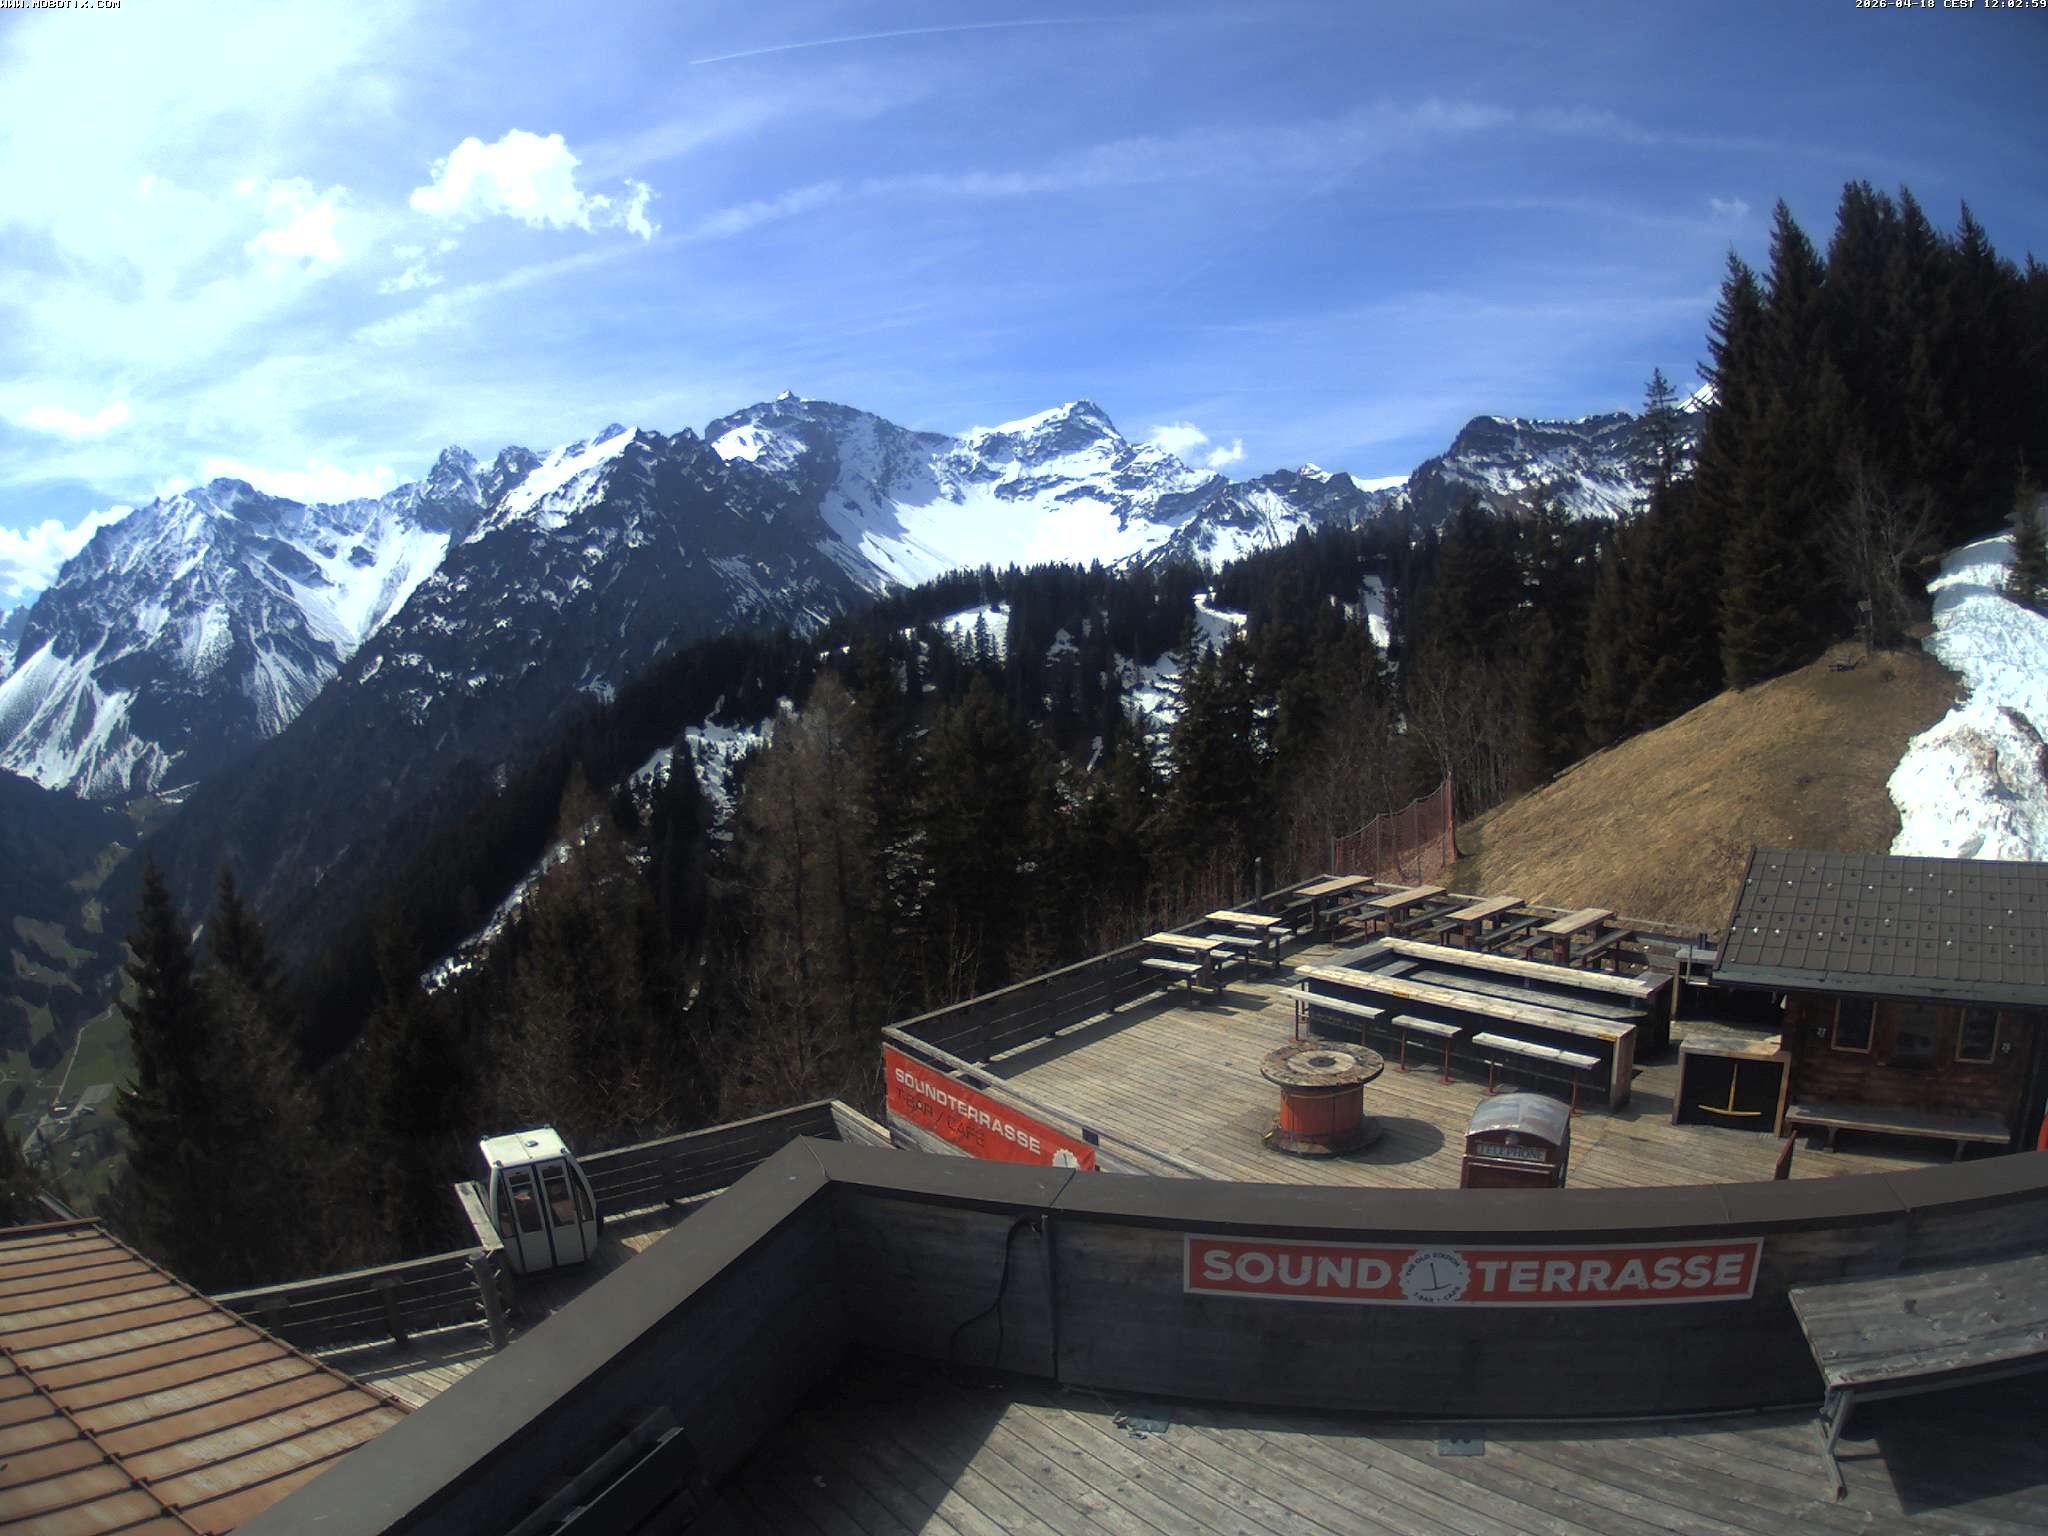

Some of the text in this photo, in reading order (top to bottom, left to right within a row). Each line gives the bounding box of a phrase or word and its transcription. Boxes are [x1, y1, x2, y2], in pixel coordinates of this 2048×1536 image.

[895, 1067, 1041, 1155] SOUNDTERRASSE
[1478, 1144, 1544, 1160] TELEPHONE
[1203, 1250, 1745, 1292] SOUND TERRASSE
